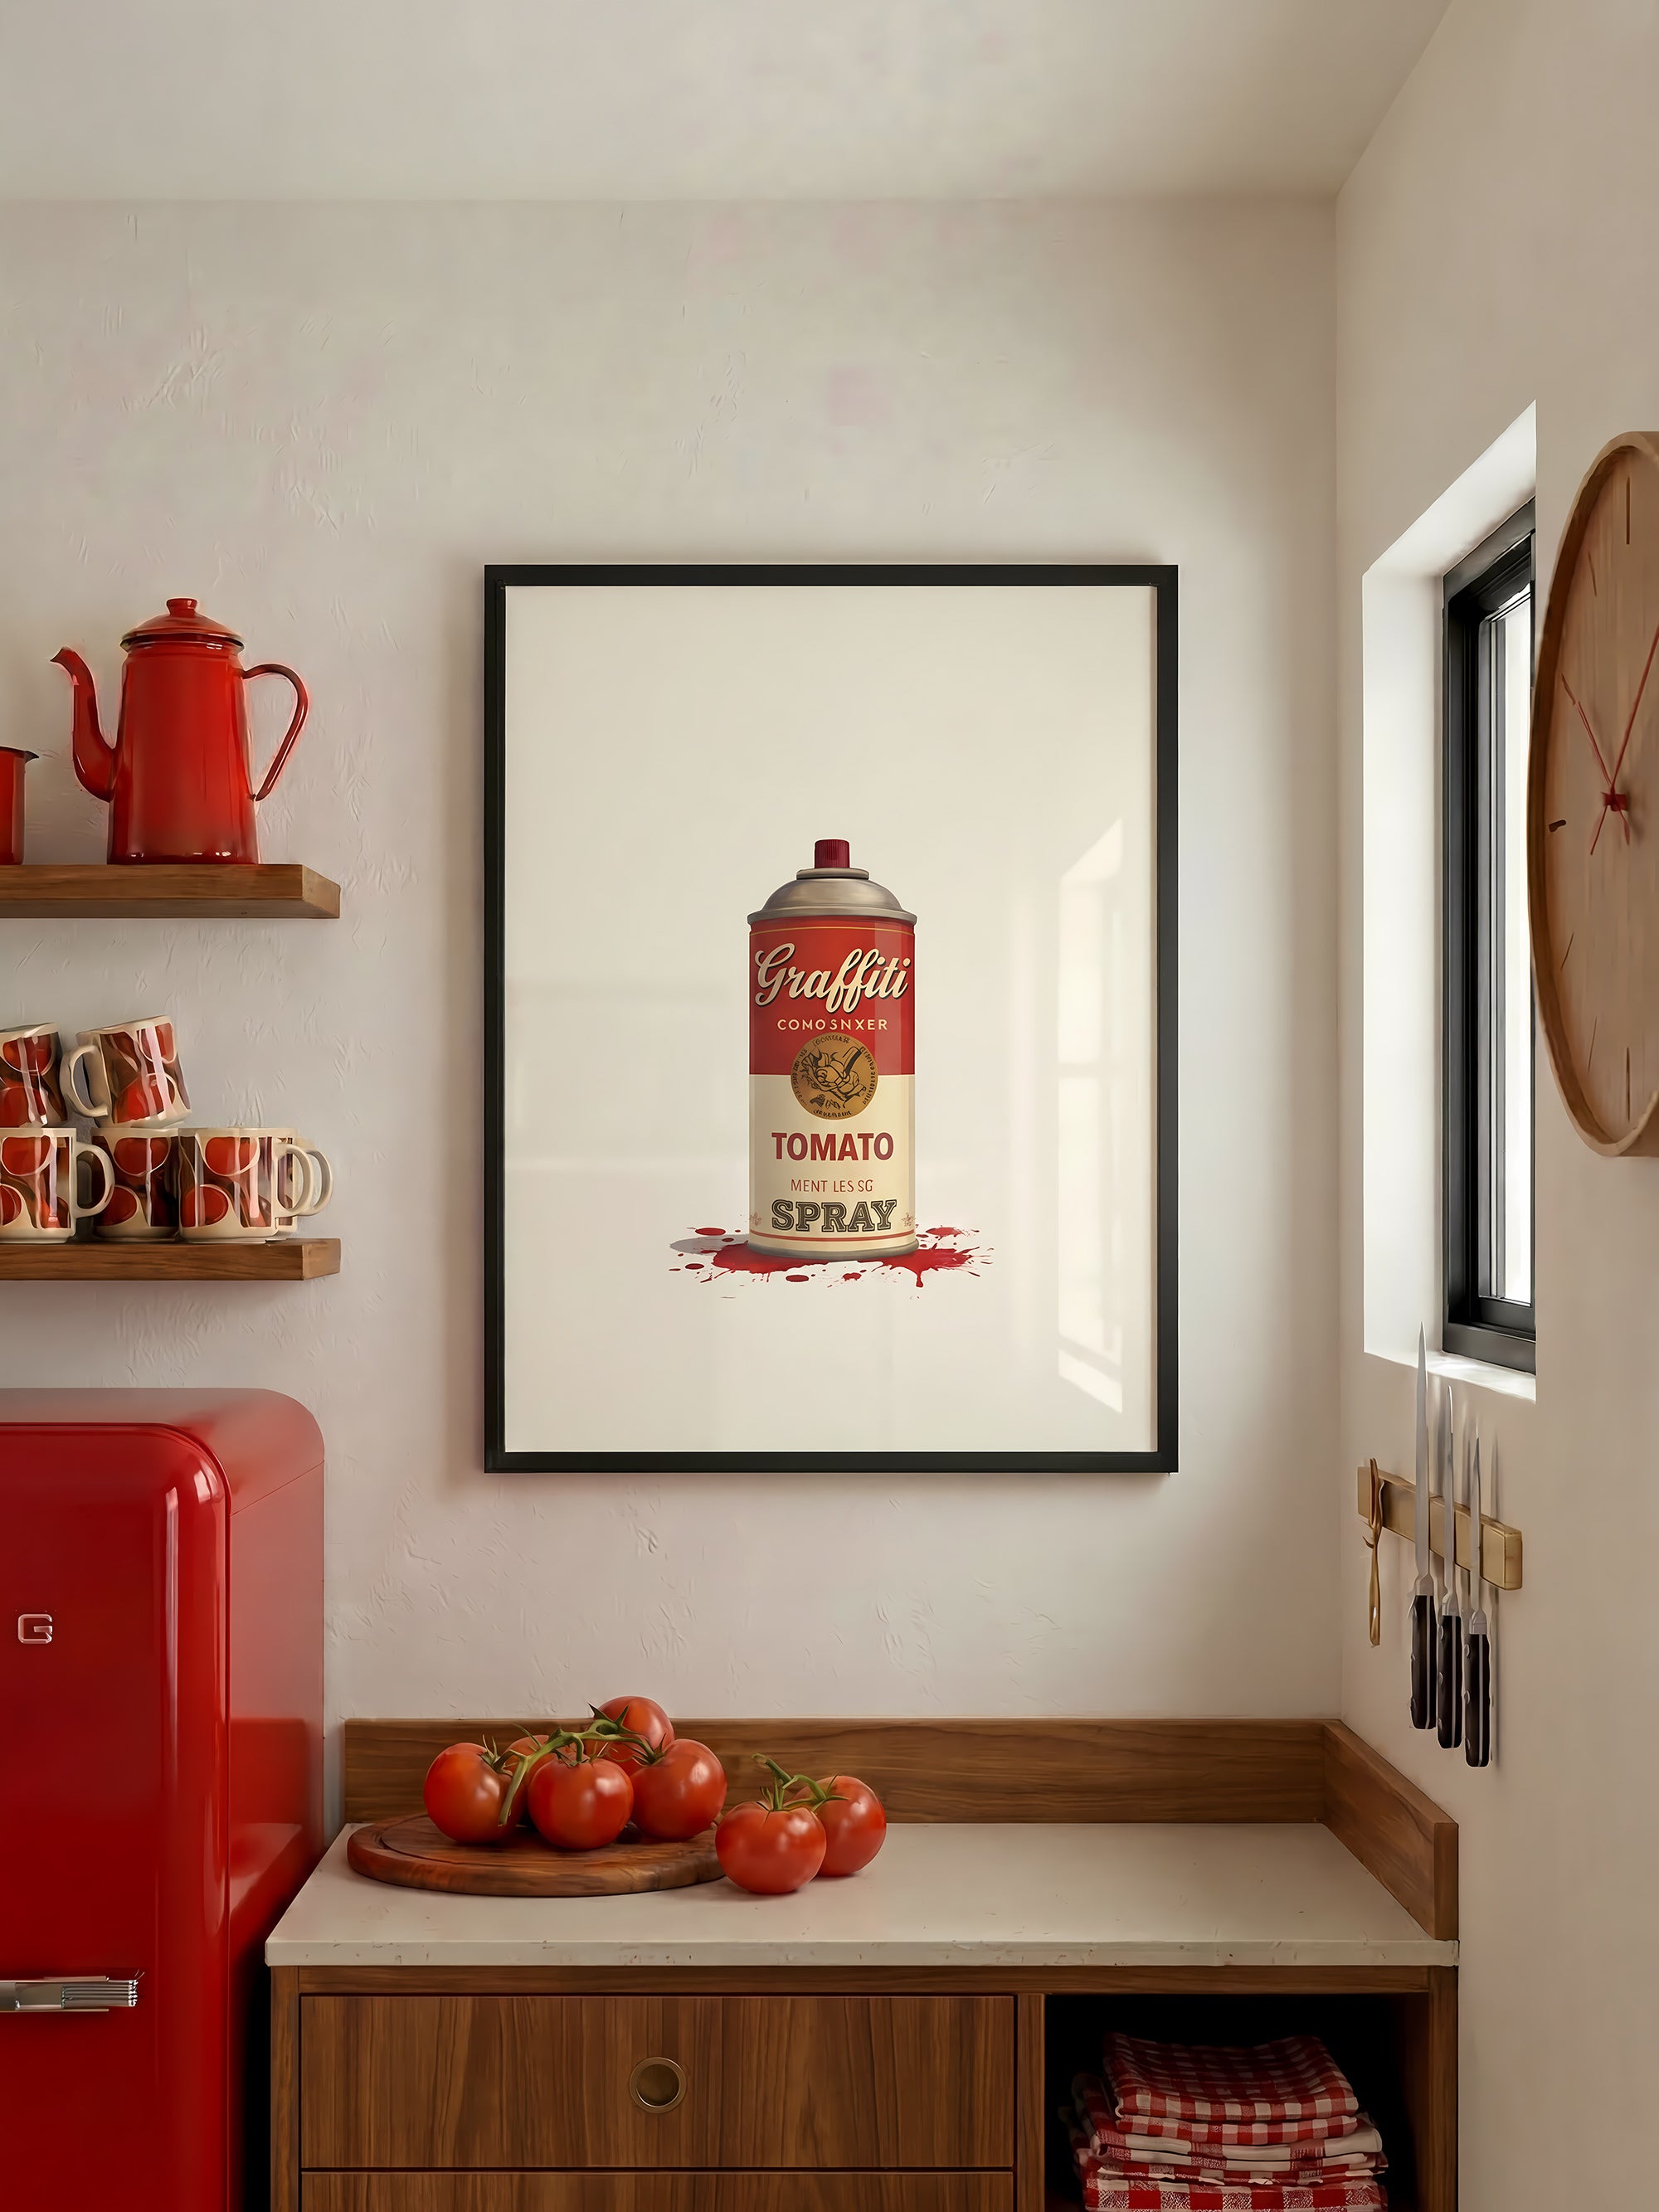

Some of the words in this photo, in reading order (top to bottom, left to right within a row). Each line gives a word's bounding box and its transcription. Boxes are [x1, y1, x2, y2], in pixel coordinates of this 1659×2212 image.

[754, 942, 912, 1014] Graffiti
[771, 1131, 894, 1161] TOMATO
[790, 1179, 828, 1193] MENT
[771, 1198, 898, 1232] SPRAY
[17, 1613, 53, 1645] G
